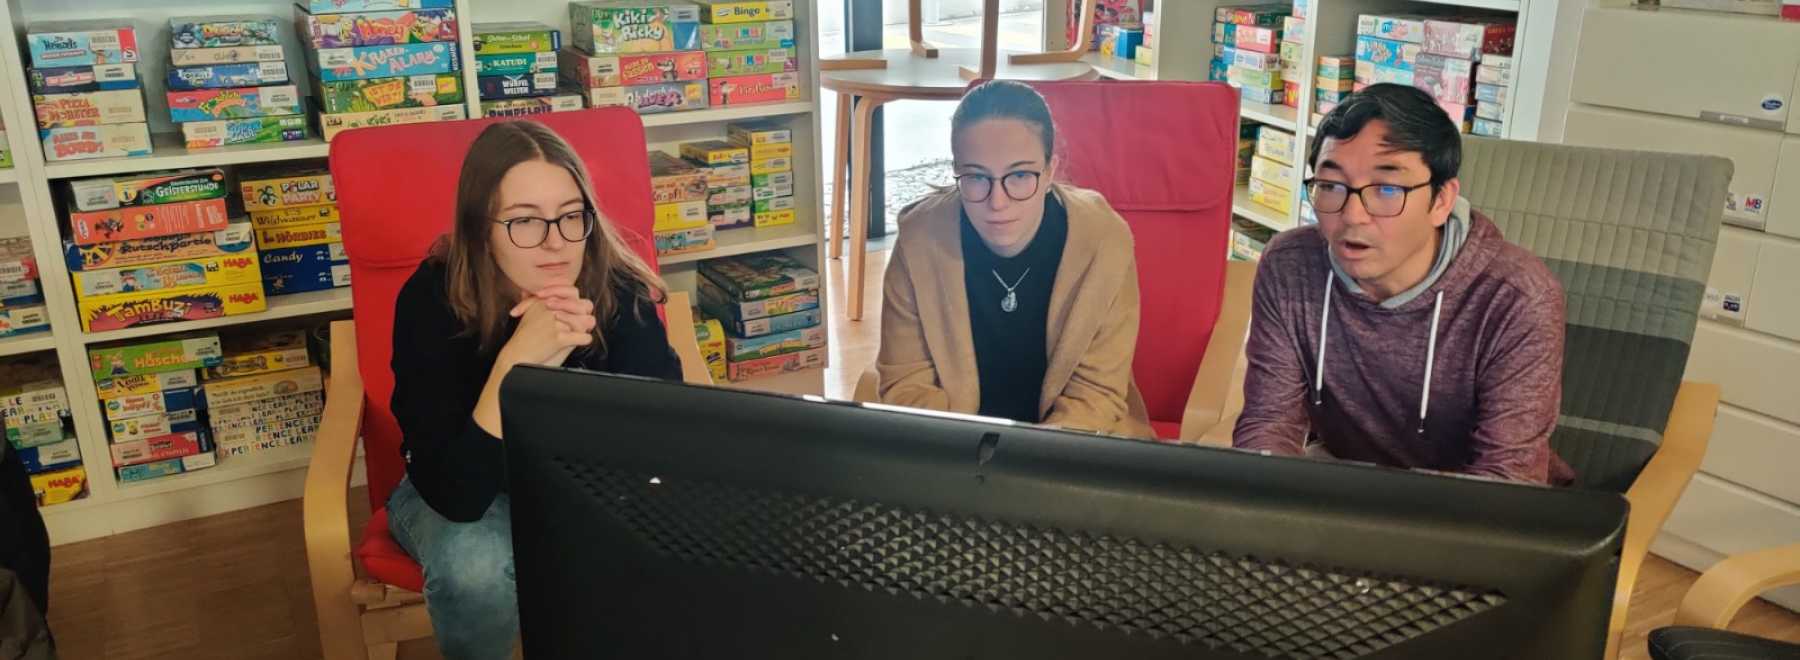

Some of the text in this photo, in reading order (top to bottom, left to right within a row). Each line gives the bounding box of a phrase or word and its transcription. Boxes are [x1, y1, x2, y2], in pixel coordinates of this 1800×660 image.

[734, 7, 760, 16] Bingo
[612, 9, 648, 28] Kiki
[622, 22, 665, 41] Ricky
[1745, 197, 1762, 210] MB
[223, 257, 252, 269] HABA
[263, 251, 303, 263] Candy
[228, 293, 258, 305] HABA
[48, 476, 81, 489] HABA
